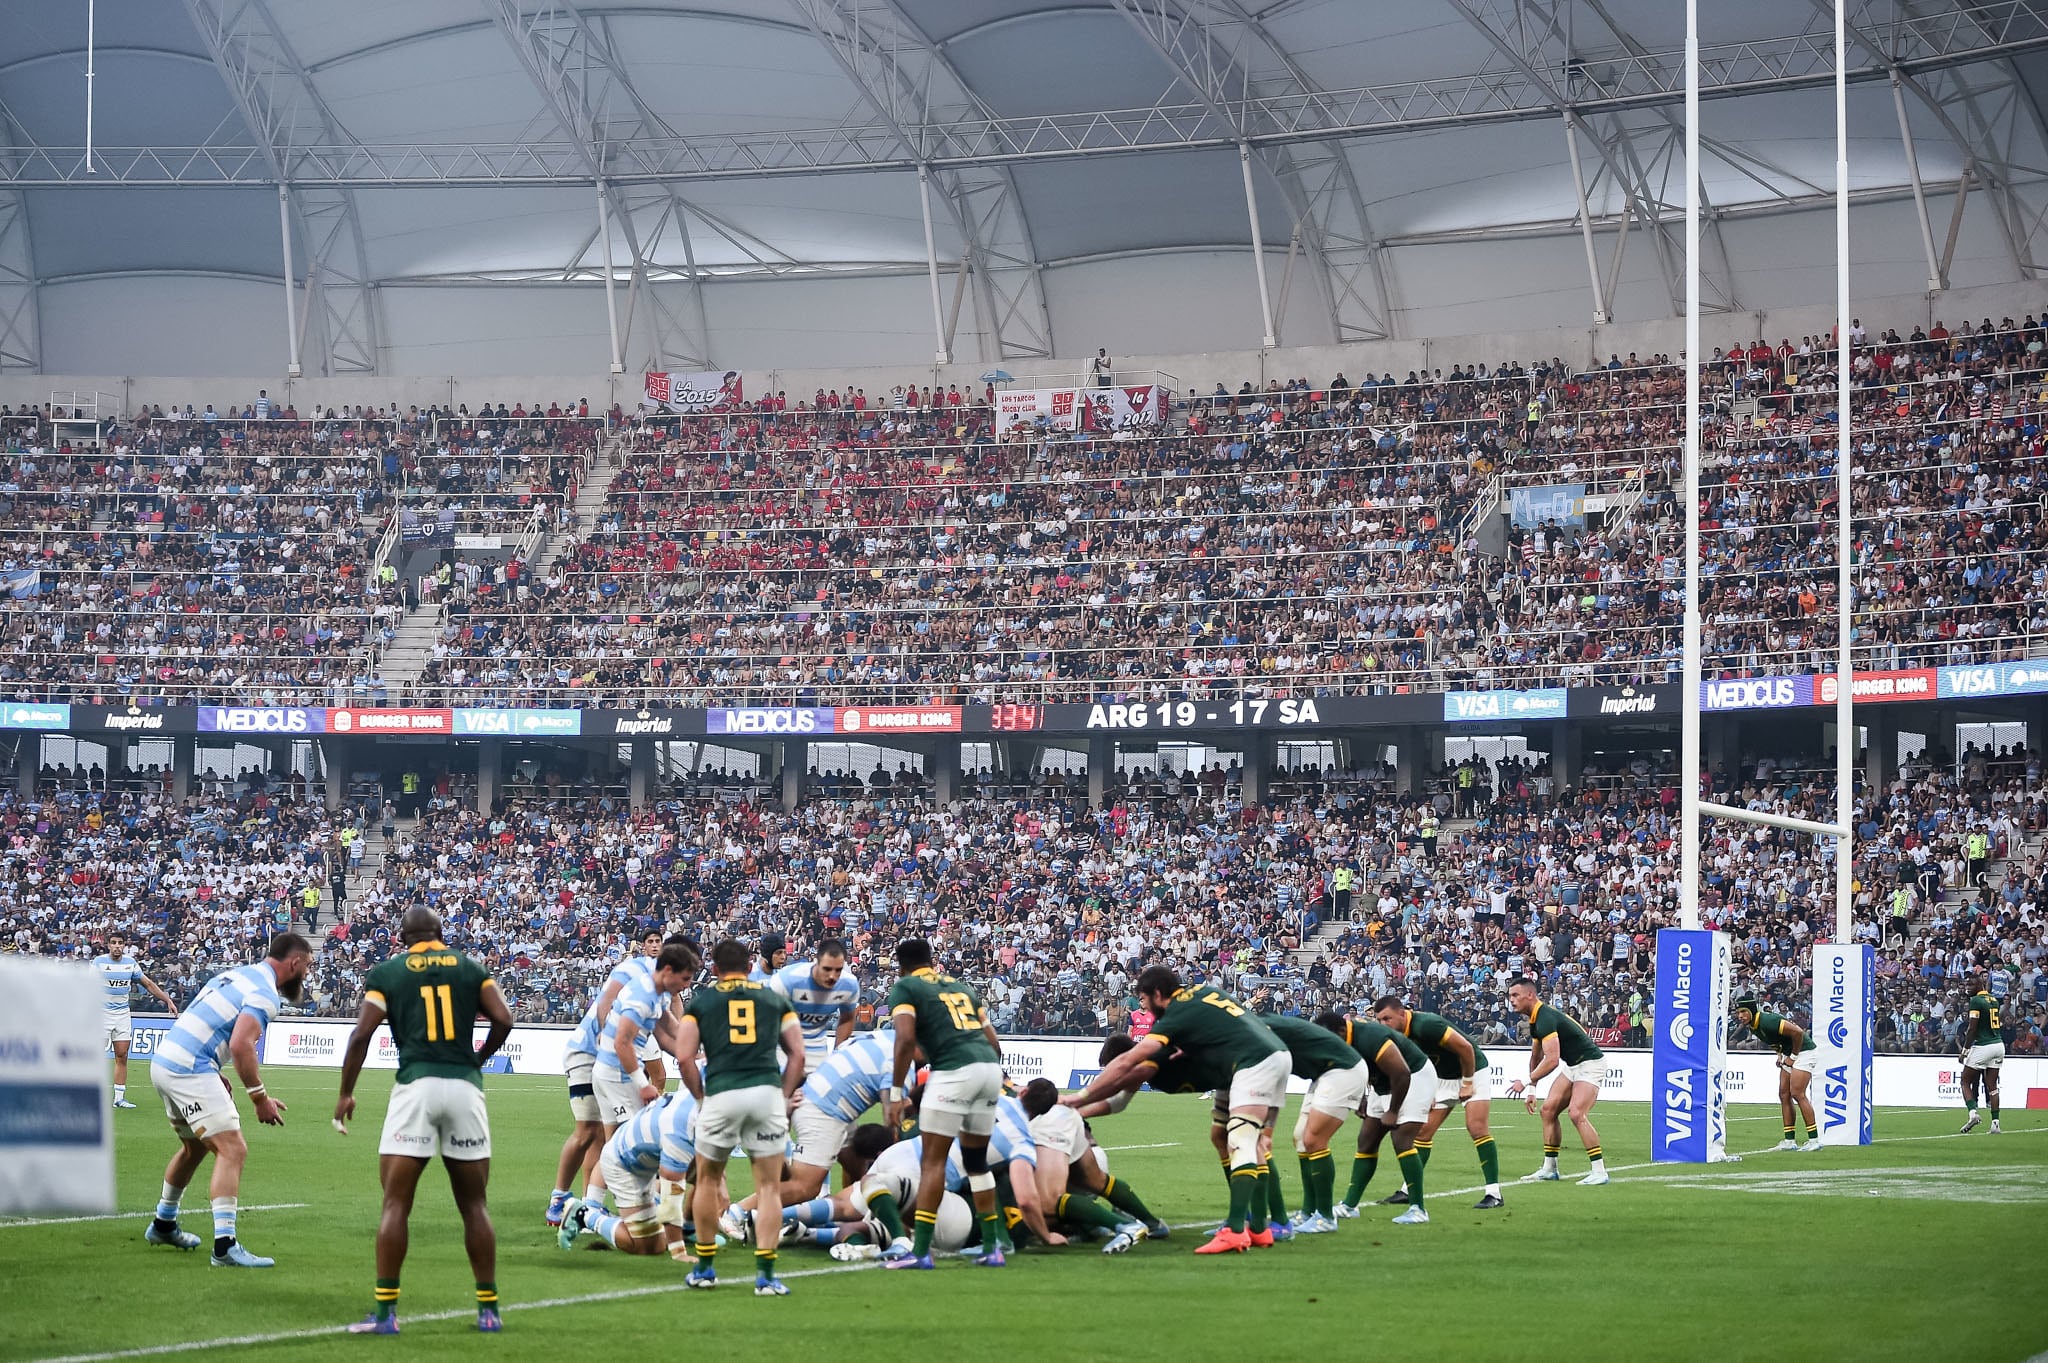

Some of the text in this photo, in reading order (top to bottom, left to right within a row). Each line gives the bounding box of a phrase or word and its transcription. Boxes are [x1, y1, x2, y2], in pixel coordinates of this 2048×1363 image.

[675, 381, 692, 391] LA
[675, 389, 717, 403] 2015
[1896, 676, 1928, 693] KING
[1947, 669, 1995, 692] VISA
[1707, 679, 1794, 708] MEDICUS
[1087, 704, 1147, 728] ARG
[1156, 702, 1196, 727] 19
[1230, 700, 1268, 725] 17
[1279, 700, 1319, 724] SA
[1455, 696, 1559, 716] VISA Macro
[1601, 694, 1655, 715] Imperial
[30, 711, 62, 721] Macro
[105, 713, 163, 730] Imperial
[216, 709, 307, 731] MEDICUS
[360, 715, 409, 728] BURGER
[412, 715, 443, 728] KING
[462, 712, 573, 731] VISA Macro
[615, 717, 672, 734] Imperial
[726, 710, 815, 732] MEDICUS
[868, 713, 919, 727] BURGER
[920, 713, 953, 727] KING
[427, 955, 457, 967] FNB
[1673, 943, 1692, 1009] Macro
[1717, 946, 1726, 1010] Macro
[1830, 956, 1844, 1013] Macro
[420, 985, 454, 1042] 11
[938, 992, 982, 1030] 12
[1990, 1007, 2000, 1029] 15
[728, 999, 756, 1045] 9
[288, 1046, 333, 1055] Garden Inn
[299, 1034, 334, 1047] Hilton
[379, 1049, 400, 1057] Gard
[1001, 1053, 1042, 1066] Hilton
[1001, 1066, 1042, 1075] rden Inn
[1666, 1069, 1693, 1149] VISA
[1712, 1070, 1723, 1143] VISA
[1824, 1065, 1848, 1134] VISA
[1863, 1065, 1872, 1133] VISA
